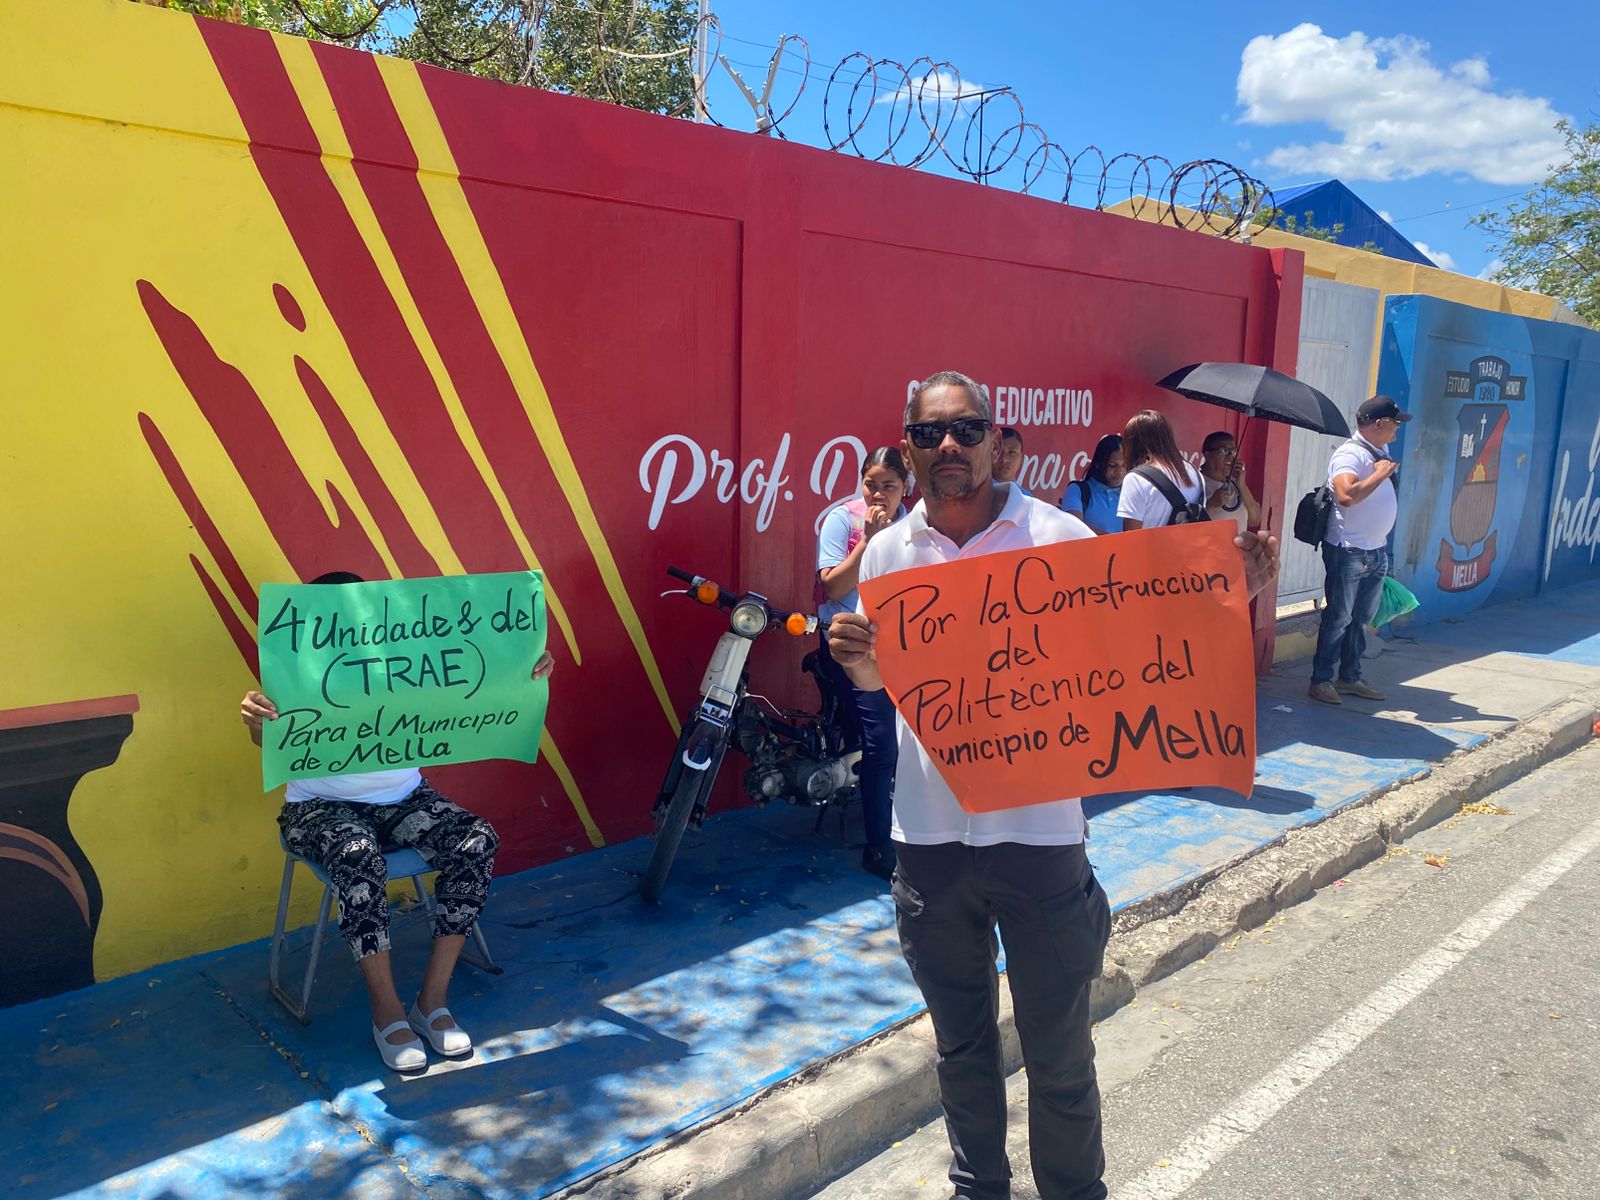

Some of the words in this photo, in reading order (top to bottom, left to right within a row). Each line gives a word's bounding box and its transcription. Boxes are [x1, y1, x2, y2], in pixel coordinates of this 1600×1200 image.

[995, 386, 1093, 427] EDUCATIVO
[638, 432, 794, 533] Prof.
[264, 598, 305, 653] 4
[490, 588, 539, 633] del
[876, 584, 957, 650] Por
[979, 574, 1011, 626] la
[1013, 553, 1230, 616] Construccion
[321, 639, 486, 709] (TRAE)
[987, 623, 1050, 673] del
[1141, 633, 1195, 685] del
[277, 708, 347, 751] Para
[357, 705, 385, 739] el
[387, 710, 519, 737] Municipio
[290, 747, 322, 773] de
[328, 737, 452, 773] Mella
[932, 727, 1048, 766] unicipio
[1058, 711, 1090, 747] de
[1087, 704, 1247, 779] Mella
